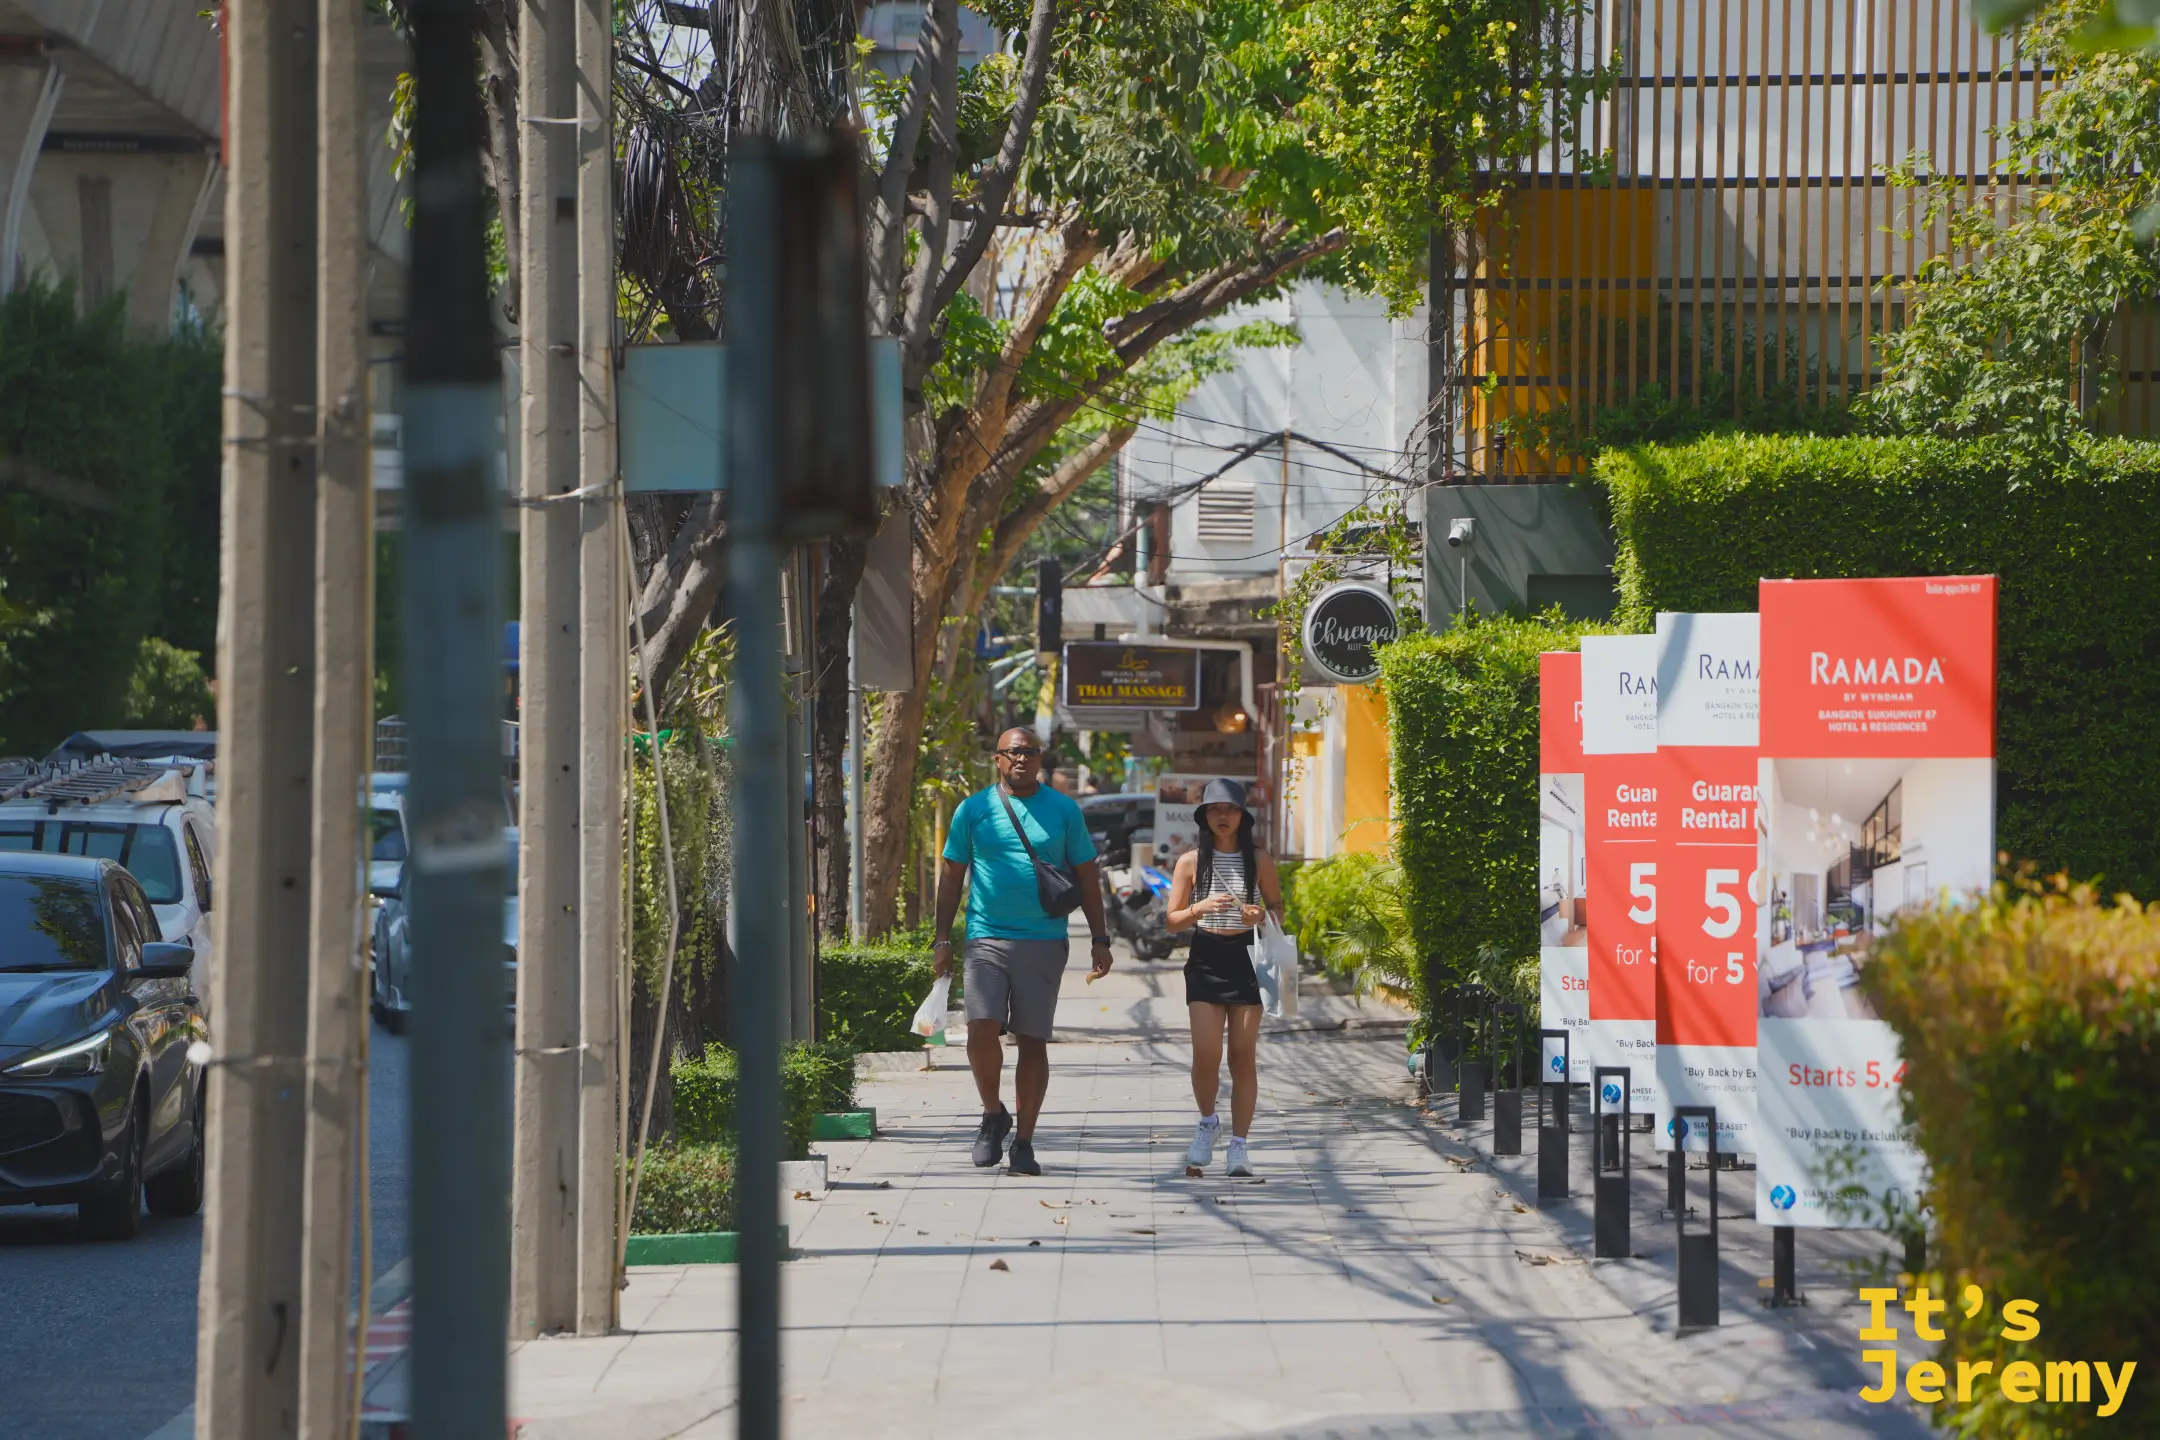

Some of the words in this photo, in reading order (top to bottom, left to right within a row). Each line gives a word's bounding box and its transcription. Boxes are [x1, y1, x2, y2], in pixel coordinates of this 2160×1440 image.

[1310, 616, 1398, 646] Chuenjai
[1699, 654, 1760, 680] RAM
[1811, 651, 1945, 685] RAMADA
[1077, 685, 1113, 697] THAI
[1118, 686, 1186, 698] MASSAGE
[1843, 692, 1857, 703] BY
[1860, 692, 1914, 703] WYNDHAM
[1818, 710, 1865, 720] BANGKOK
[1867, 710, 1923, 720] SUKHUMVIT
[1828, 722, 1858, 733] HOTEL
[1869, 722, 1928, 733] RESIDENCES
[1681, 808, 1747, 829] Rental
[1628, 862, 1657, 925] 5
[1701, 868, 1758, 939] 5
[1616, 944, 1643, 965] for
[1687, 960, 1718, 984] for
[1725, 952, 1745, 985] 5
[1636, 1040, 1655, 1048] Back
[1708, 1068, 1730, 1077] Back
[1732, 1068, 1743, 1079] by
[1789, 1063, 1856, 1087] Starts
[1726, 1123, 1748, 1131] ASSET
[1814, 1128, 1841, 1139] Back
[1844, 1129, 1857, 1141] by
